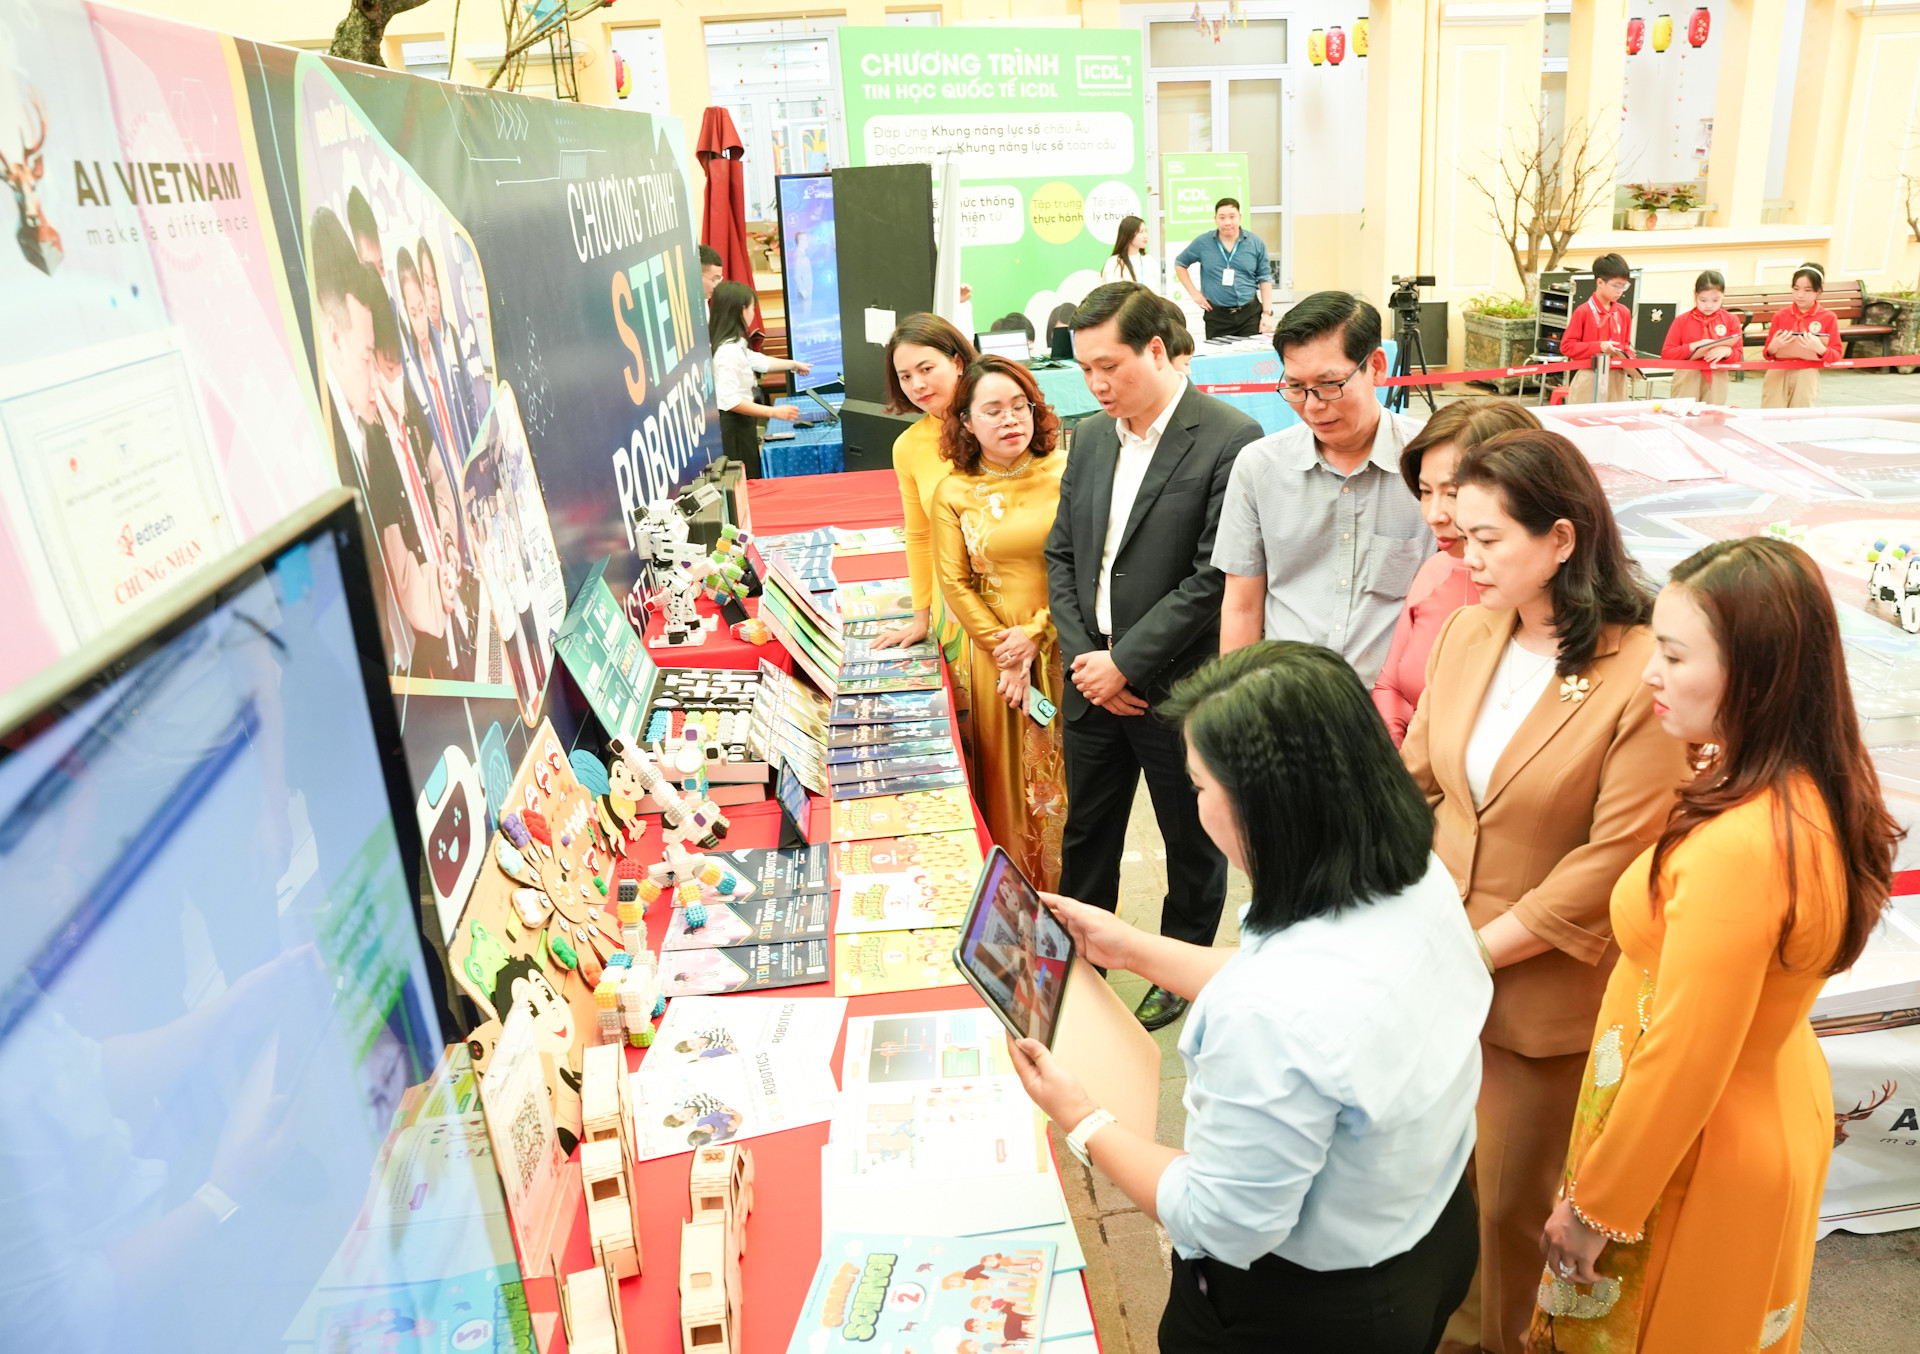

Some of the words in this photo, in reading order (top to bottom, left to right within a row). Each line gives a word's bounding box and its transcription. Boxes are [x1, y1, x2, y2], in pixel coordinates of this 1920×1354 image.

[861, 50, 981, 76] CHƯƠNG
[988, 48, 1059, 76] TRÌNH
[1084, 64, 1124, 79] ICDL
[862, 84, 890, 99] TIN
[896, 83, 936, 103] HỌC
[942, 77, 995, 99] QUỐC
[998, 77, 1018, 98] TẾ
[1021, 83, 1058, 98] ICDL
[873, 127, 901, 139] Đáp
[905, 127, 927, 139] ứng
[932, 125, 970, 138] Khung
[974, 125, 1004, 138] năng
[1007, 124, 1024, 138] lực
[1027, 123, 1040, 135] số
[875, 144, 935, 158] DigComp
[957, 142, 995, 155] Khung
[998, 141, 1028, 154] năng
[1031, 140, 1048, 154] lực
[1051, 139, 1064, 151] số
[74, 160, 111, 207] AI
[113, 161, 242, 206] VIETNAM
[1177, 188, 1210, 202] ICDL
[566, 174, 641, 263] CHƯƠNG
[640, 158, 680, 240] TRÌNH
[980, 196, 1015, 208] thống
[1032, 200, 1051, 211] Tập
[1054, 200, 1082, 209] trung
[961, 212, 986, 225] hiện
[1033, 214, 1056, 226] thực
[1058, 212, 1084, 222] hành
[1093, 211, 1100, 223] lý
[86, 225, 140, 246] make
[149, 224, 161, 241] a
[167, 214, 250, 239] difference
[611, 244, 696, 406] STEM
[612, 362, 706, 552] ROBOTICS
[135, 512, 176, 547] edtech
[114, 560, 166, 605] CHỨNG
[165, 537, 203, 574] NHẬN
[764, 851, 778, 878] ROBOTICS
[762, 878, 775, 896] STEM
[759, 921, 774, 940] STEM
[756, 964, 770, 984] STEM
[771, 1002, 795, 1044] ROBOTICS
[755, 1052, 777, 1096] ROBOTICS
[1888, 1107, 1919, 1132] A
[820, 1261, 861, 1328] SMART
[842, 1252, 899, 1343] SCIENCE
[896, 1291, 922, 1303] 2
